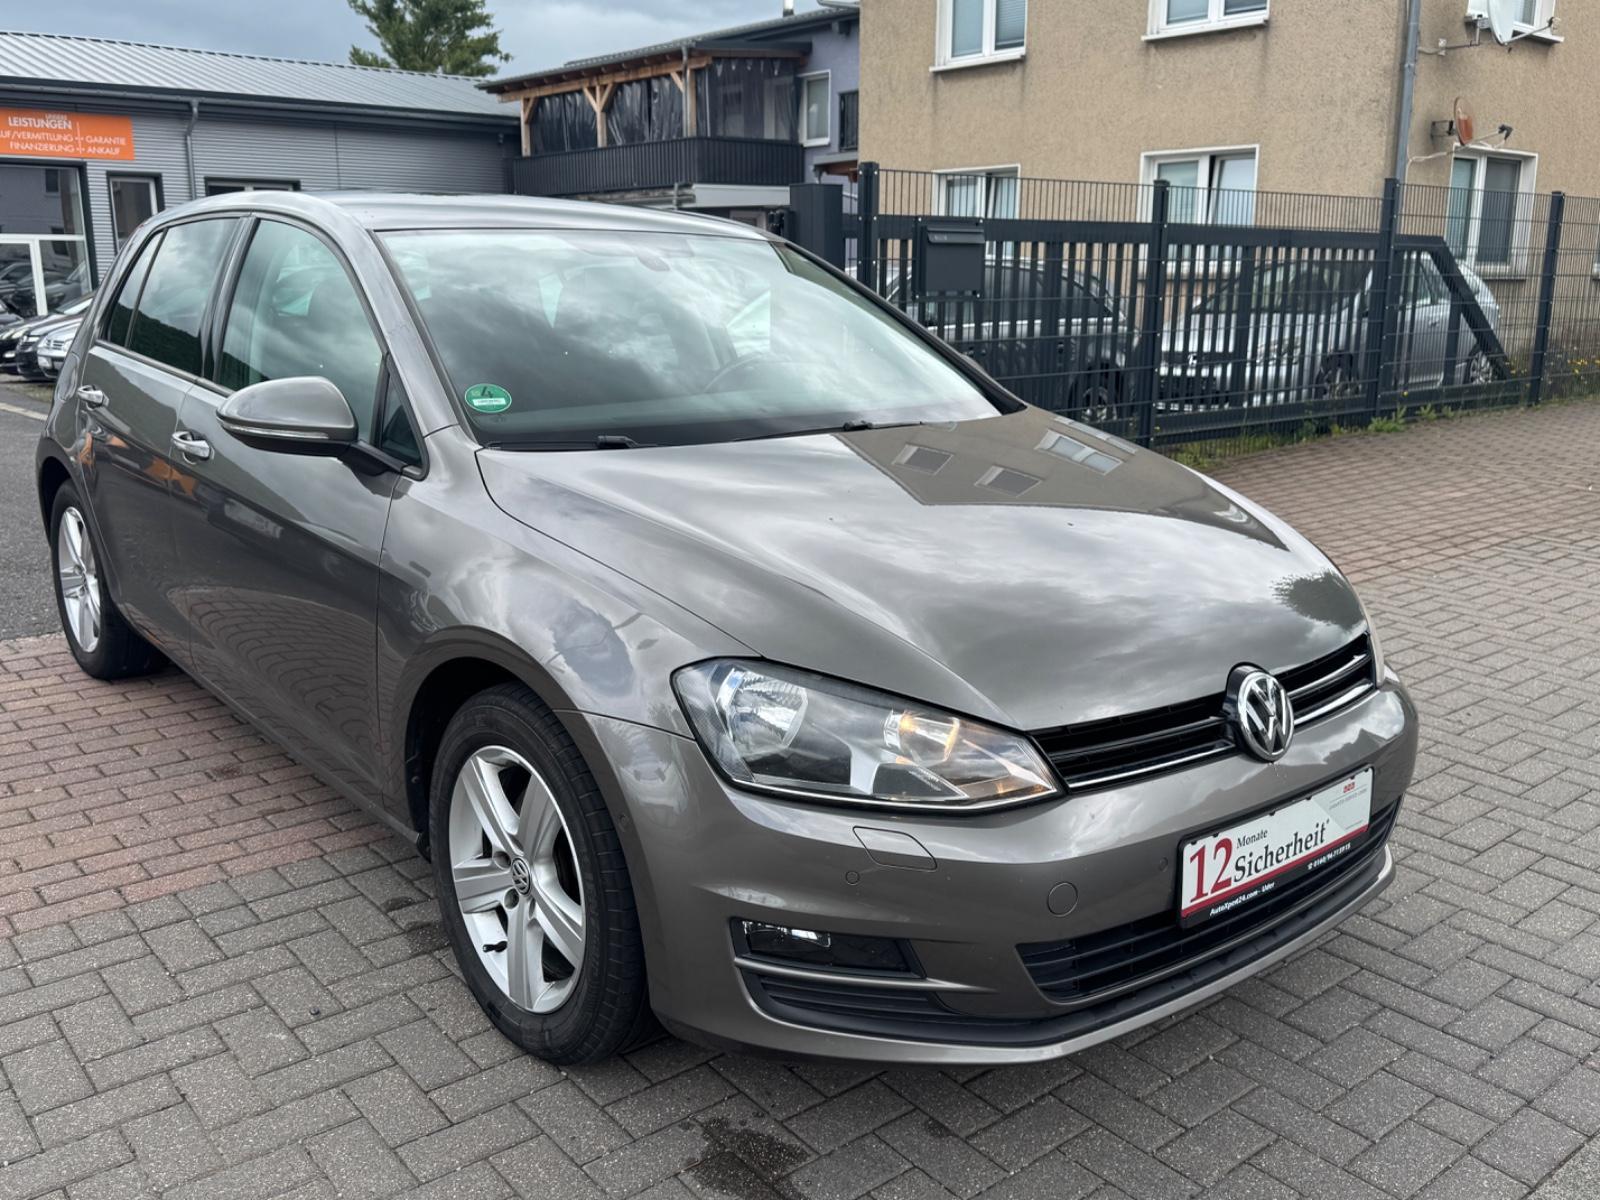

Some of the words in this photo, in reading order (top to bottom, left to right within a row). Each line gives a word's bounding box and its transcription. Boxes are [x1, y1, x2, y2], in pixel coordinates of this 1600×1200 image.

[8, 117, 72, 129] LEISTUNGEN
[85, 136, 126, 145] GARANTIE
[10, 142, 75, 152] FINANZIERUNG
[87, 147, 120, 155] ANKAUF
[1190, 837, 1232, 903] 12
[1236, 829, 1268, 849] Monate
